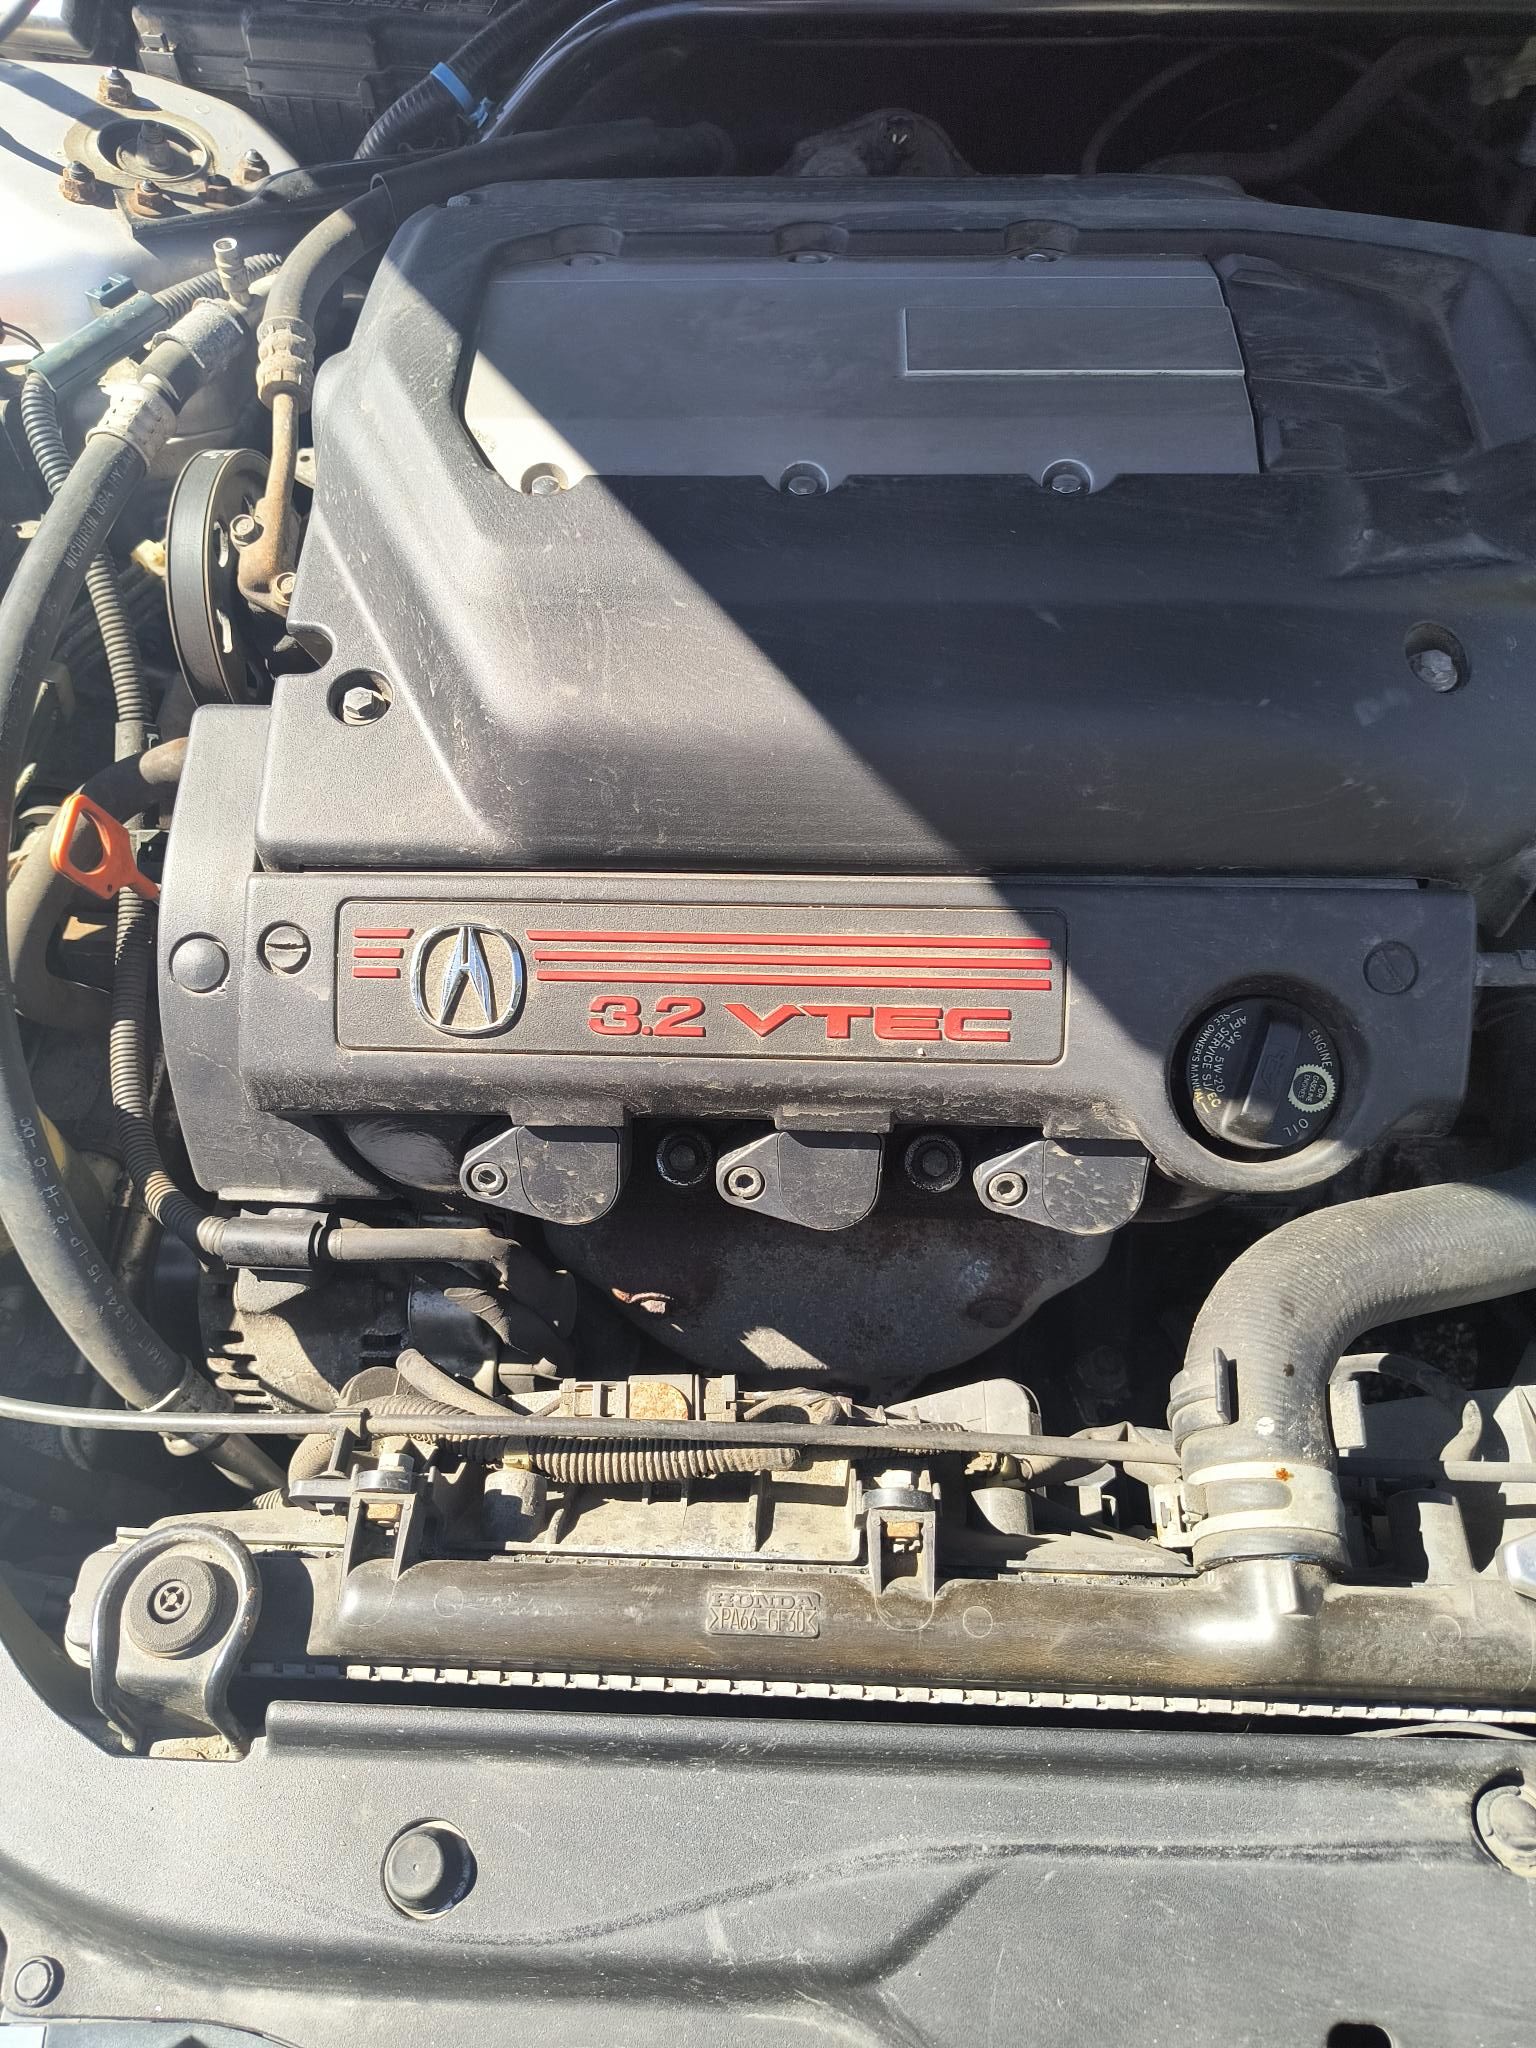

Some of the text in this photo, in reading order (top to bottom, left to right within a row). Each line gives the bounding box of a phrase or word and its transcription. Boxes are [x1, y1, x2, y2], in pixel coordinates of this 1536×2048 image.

[92, 488, 114, 516] USA
[588, 995, 1013, 1043] 3.2 VTEC
[1191, 1024, 1215, 1062] OWNER'S
[1202, 1015, 1247, 1108] API SERVICE SJ/EC
[1213, 1031, 1242, 1093] SAE 5W-20
[1307, 1028, 1333, 1068] ENGINE
[1190, 1064, 1204, 1104] MANUAL
[1315, 1084, 1327, 1099] FOR
[1283, 1118, 1309, 1137] OIL
[711, 1591, 817, 1611] HONDA
